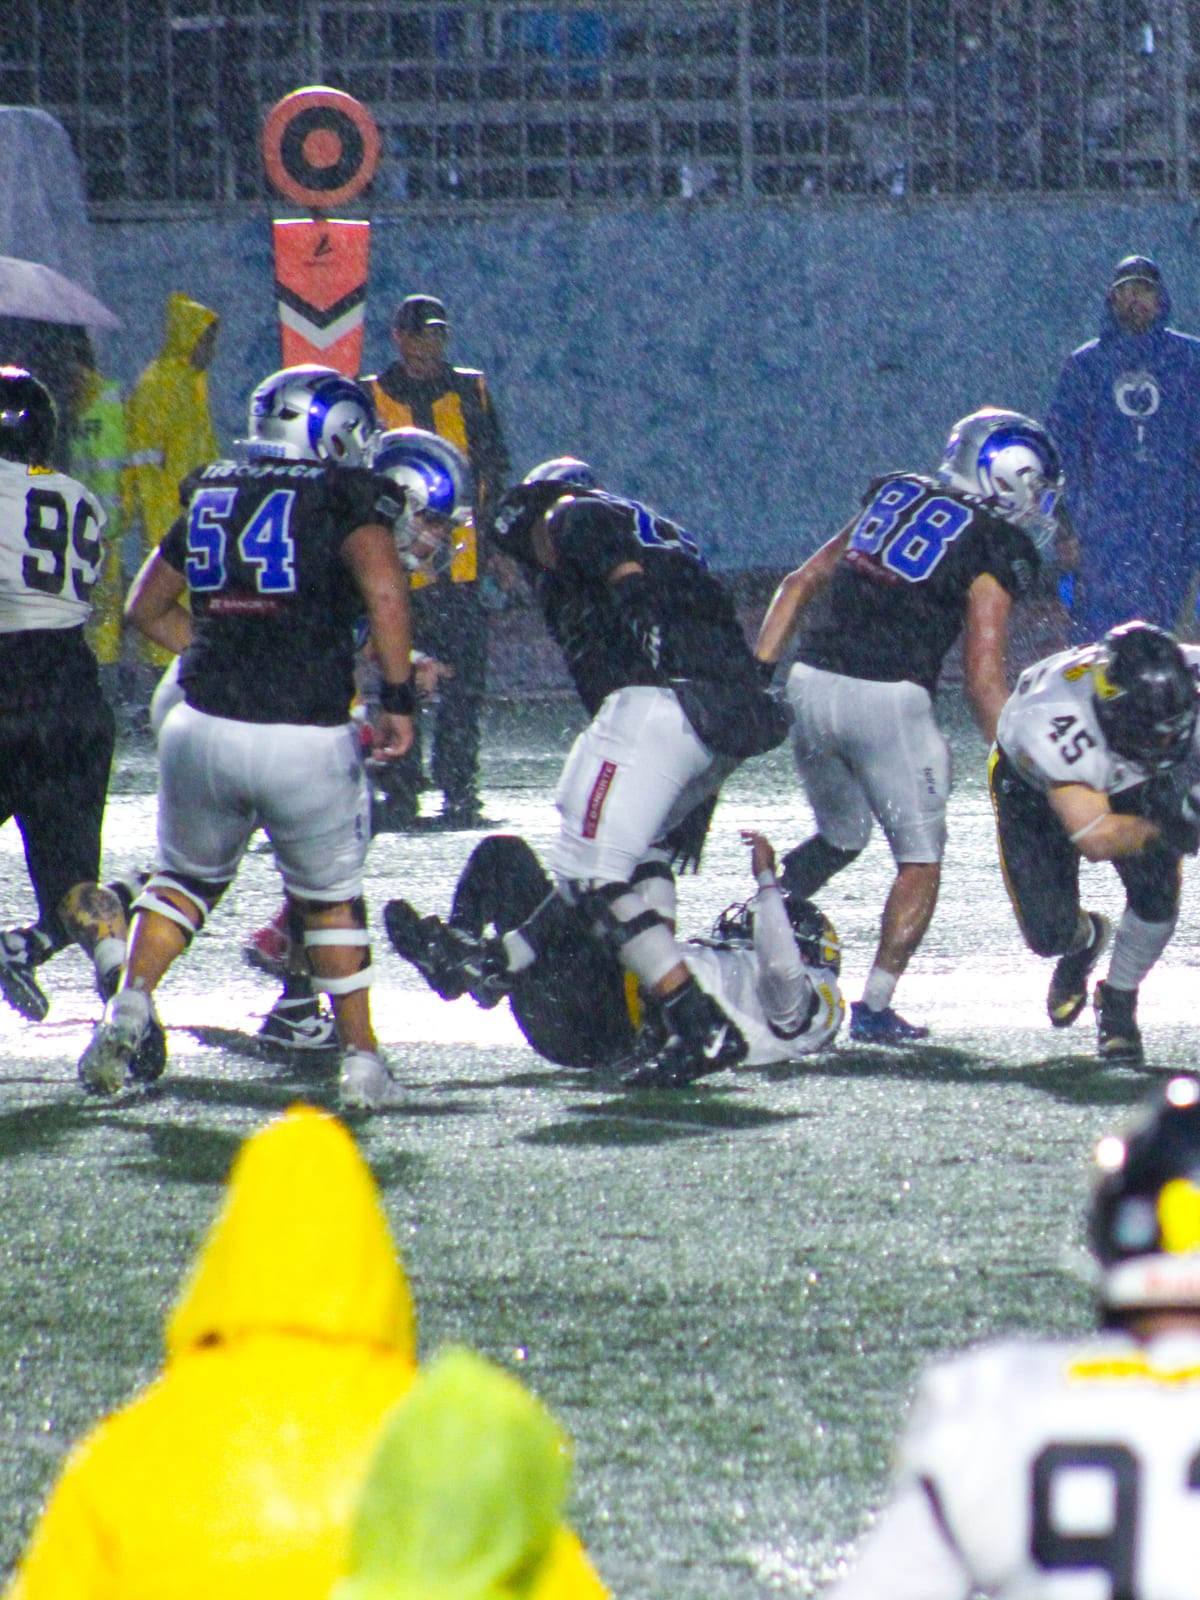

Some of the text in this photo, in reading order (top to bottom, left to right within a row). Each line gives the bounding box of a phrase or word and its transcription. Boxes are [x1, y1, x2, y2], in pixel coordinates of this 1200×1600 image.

[22, 487, 102, 602] 99
[185, 487, 297, 593] 54
[848, 480, 974, 583] 88
[1048, 714, 1098, 766] 45
